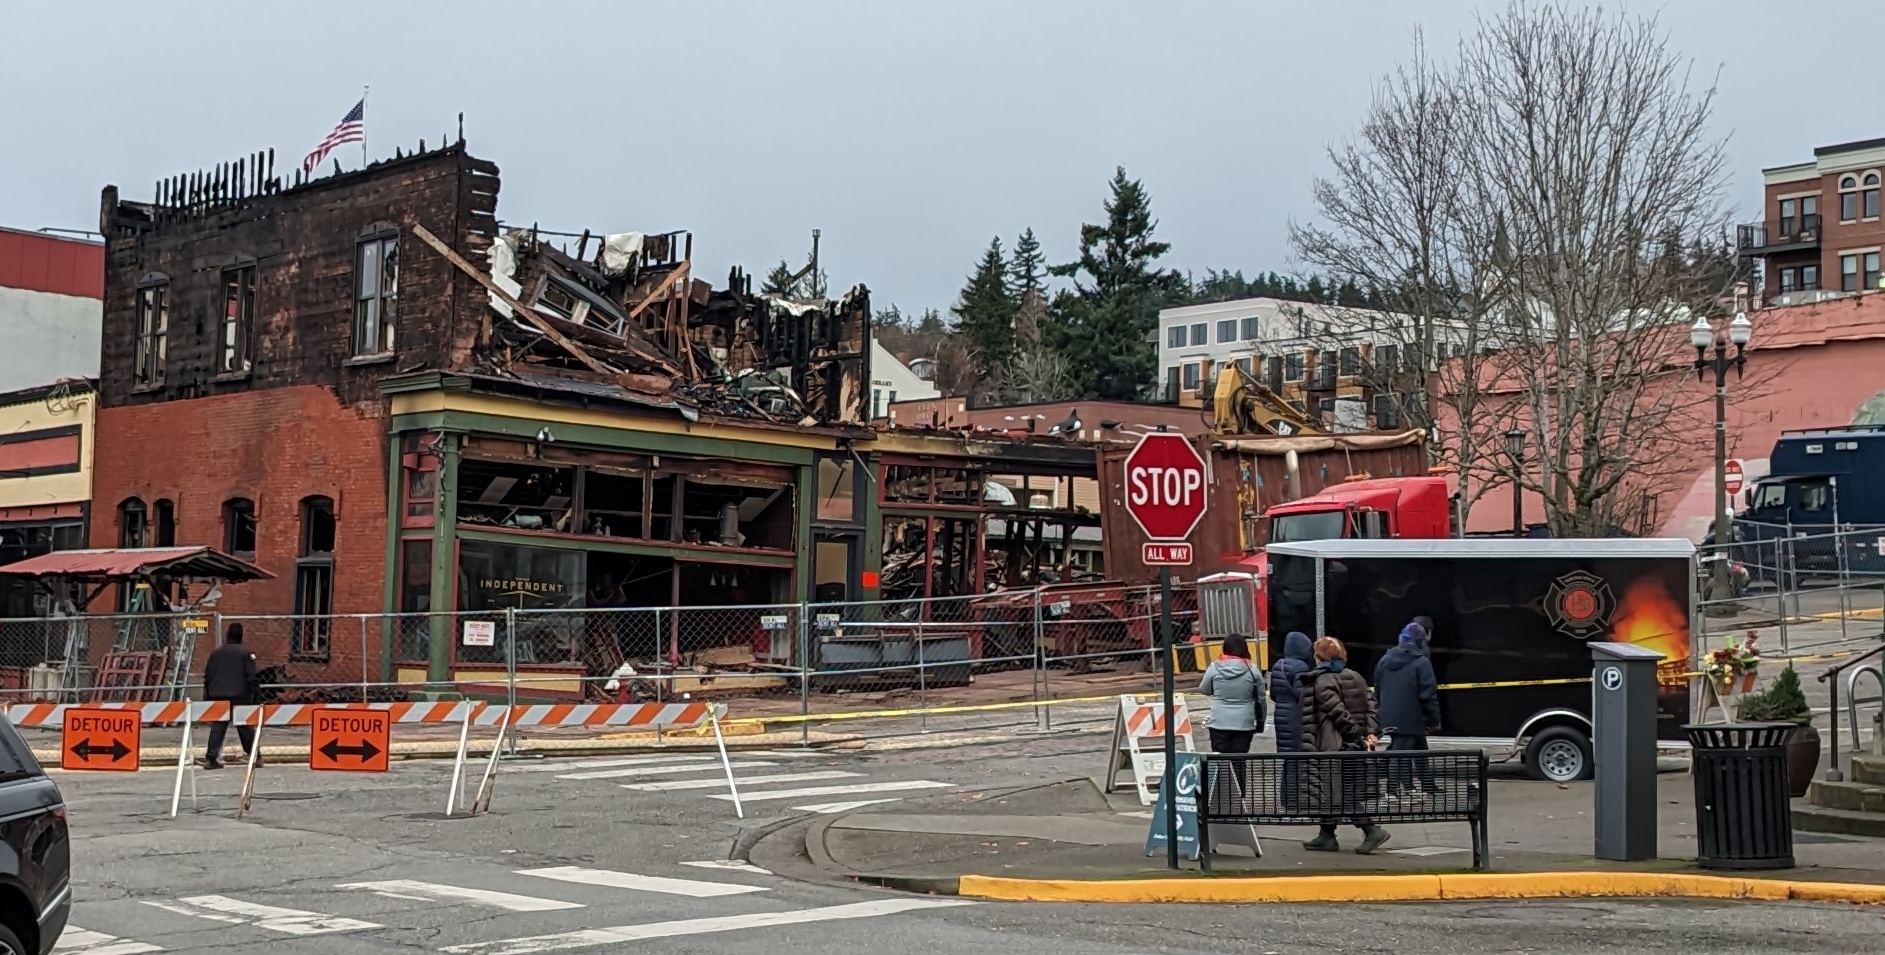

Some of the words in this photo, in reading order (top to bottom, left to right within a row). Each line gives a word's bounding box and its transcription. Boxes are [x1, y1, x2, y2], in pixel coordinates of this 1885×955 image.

[1132, 467, 1201, 507] STOP
[1147, 548, 1165, 560] ALL
[1170, 548, 1188, 560] WAY
[480, 579, 563, 593] INDEPENDENT
[1607, 670, 1619, 686] P
[71, 717, 133, 733] DETOUR
[319, 717, 383, 733] DETOUR
